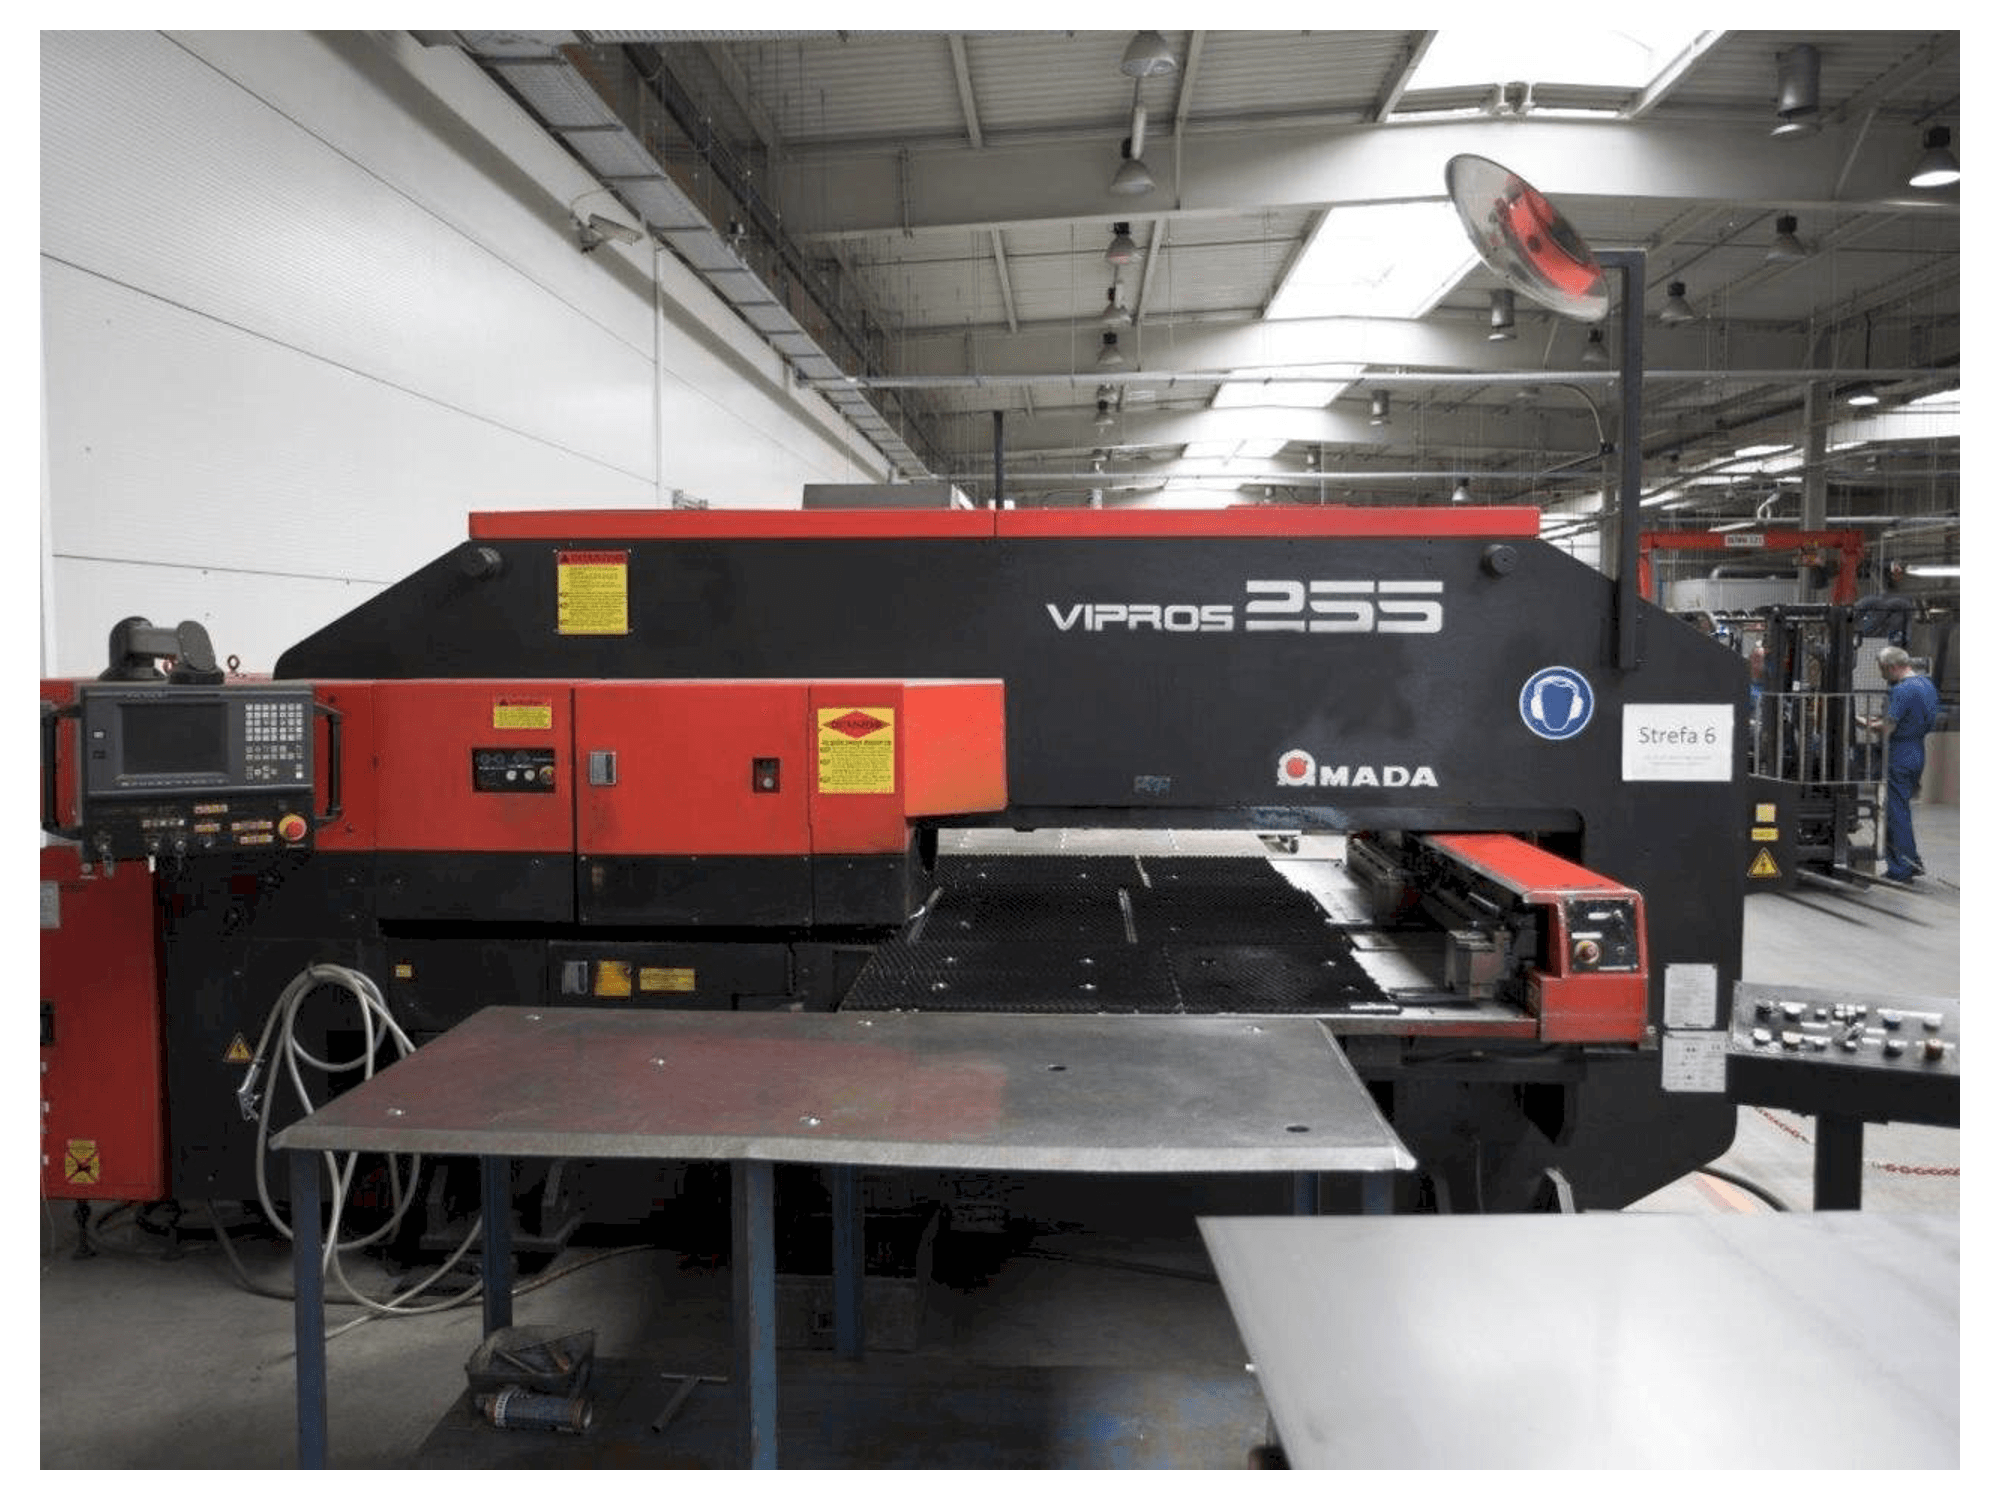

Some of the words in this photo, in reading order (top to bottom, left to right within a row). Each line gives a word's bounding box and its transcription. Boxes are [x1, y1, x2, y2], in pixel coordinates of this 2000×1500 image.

[1046, 604, 1234, 631] VIPROS
[1246, 580, 1443, 633] 255
[1638, 727, 1697, 744] Strefa
[1704, 727, 1716, 744] 6
[1277, 749, 1439, 787] AMADA
